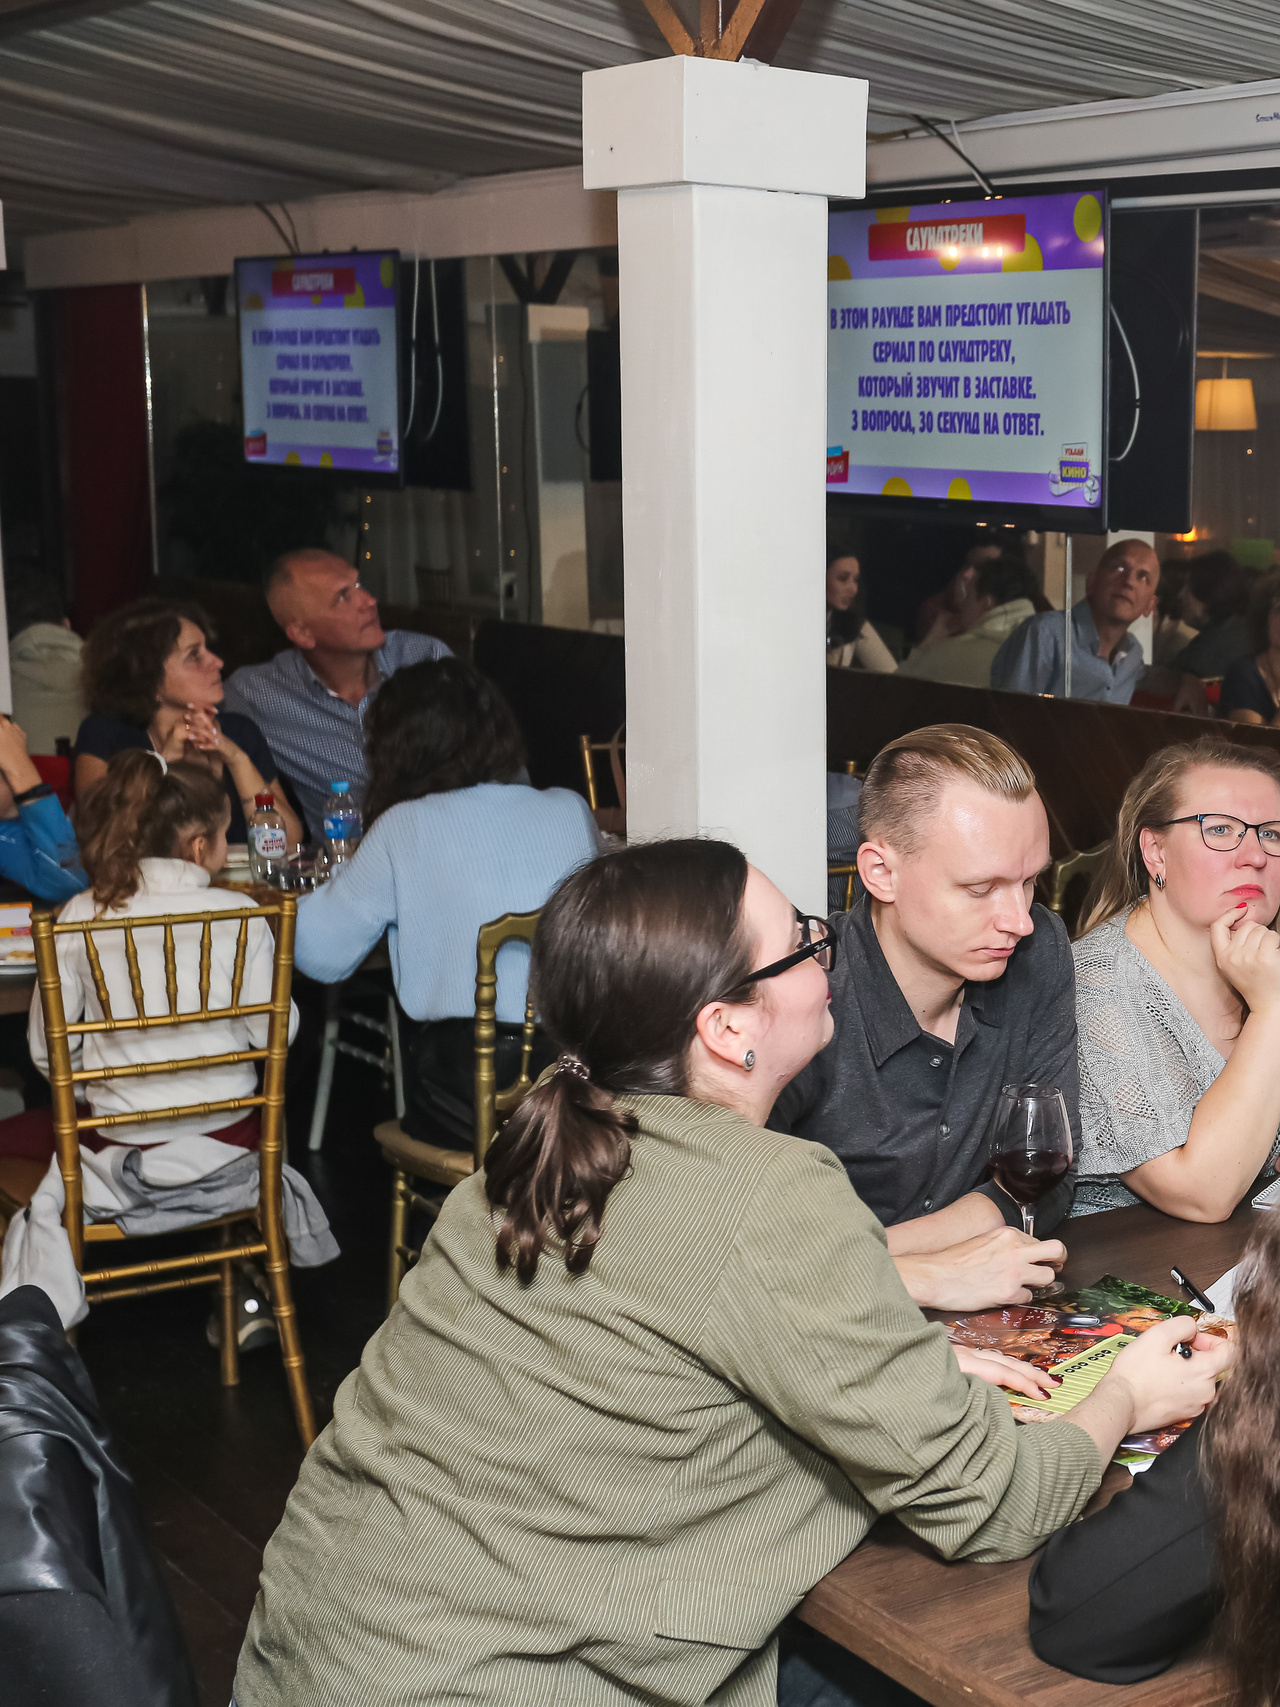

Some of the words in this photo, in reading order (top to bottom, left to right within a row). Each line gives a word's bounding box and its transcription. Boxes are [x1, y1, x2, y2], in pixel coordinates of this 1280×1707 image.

[905, 222, 984, 252] САУНДТРЕКИ
[830, 307, 838, 330] В
[840, 307, 869, 330] ЭТОМ
[871, 305, 915, 329] РАУНДЕ
[917, 305, 942, 328] ВАМ
[946, 302, 1013, 327] ПРЕДСТОИТ
[1016, 300, 1071, 326] УГАДАТЬ
[872, 340, 916, 364] СЕРИАЛ
[918, 340, 935, 363] ПО
[938, 339, 1016, 365] САУНДТРЕКУ,
[857, 372, 914, 398] КОТОРЫЙ
[916, 375, 960, 399] ЗВУЧИТ
[963, 376, 972, 399] В
[974, 376, 1037, 400] ЗАСТАВКЕ.
[851, 409, 859, 432] 3
[861, 409, 916, 435] ВОПРОСА,
[918, 410, 934, 434] 30
[936, 411, 981, 435] СЕКУНД
[983, 412, 1000, 435] НА
[1002, 412, 1045, 436] ОТВЕТ.
[1062, 466, 1087, 478] КИНО
